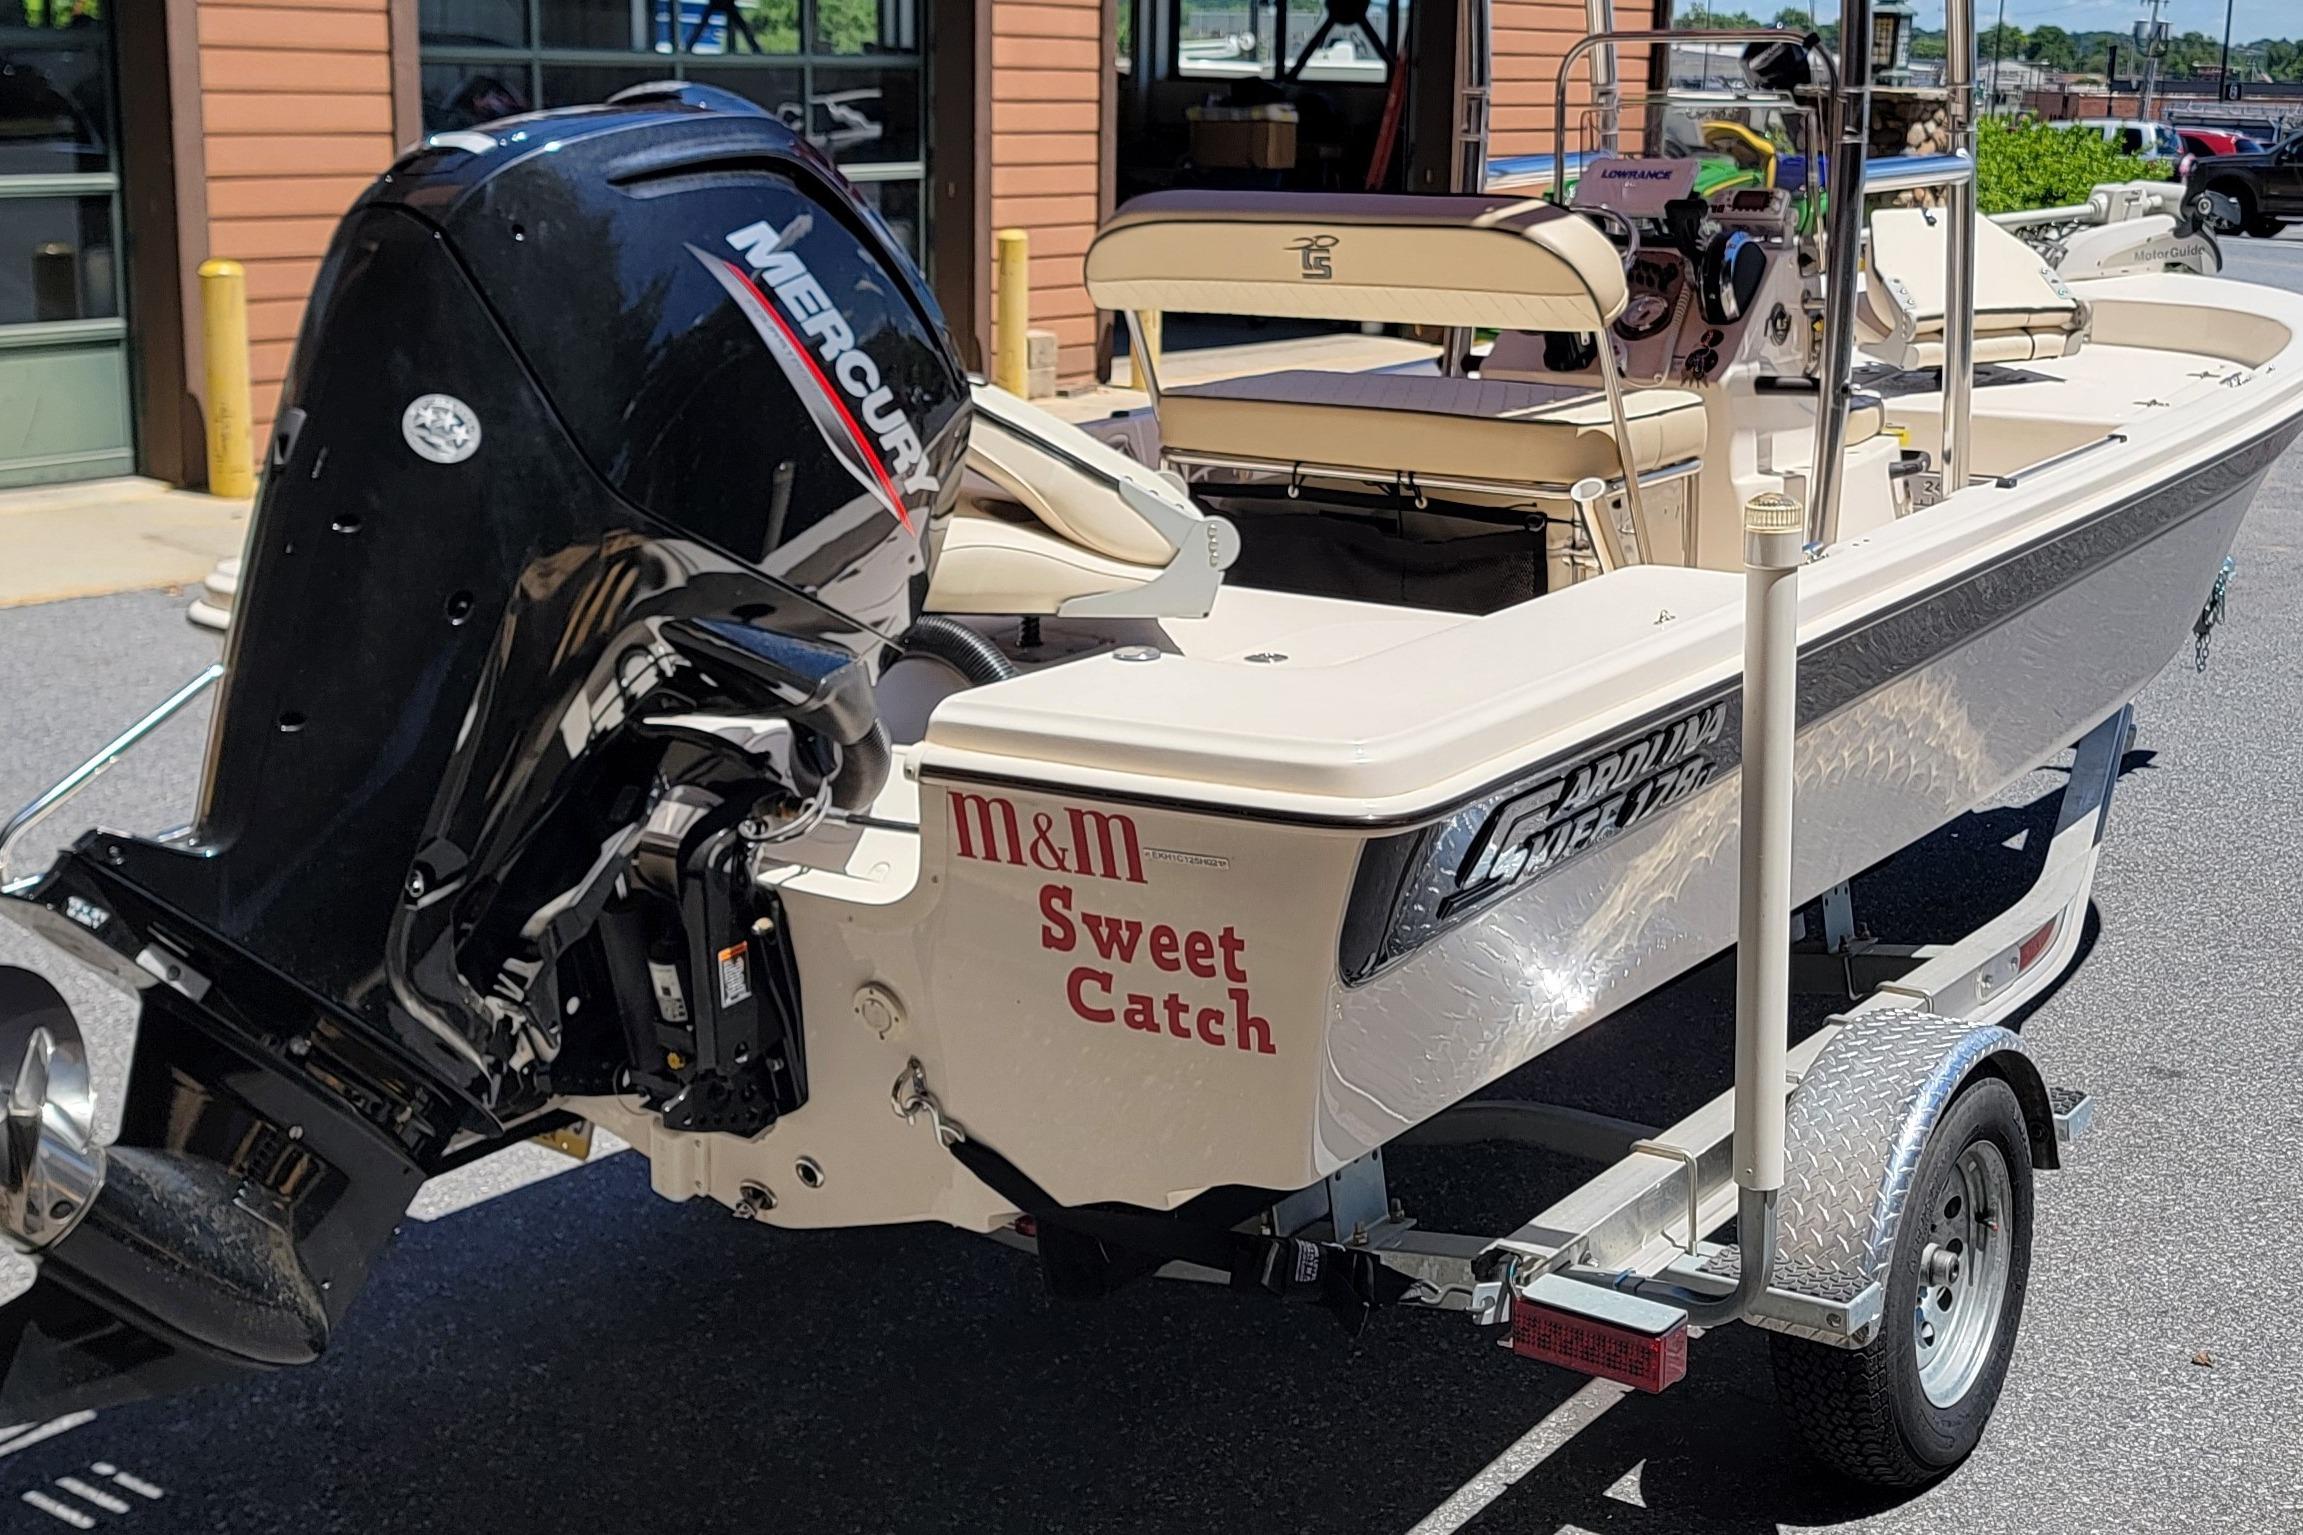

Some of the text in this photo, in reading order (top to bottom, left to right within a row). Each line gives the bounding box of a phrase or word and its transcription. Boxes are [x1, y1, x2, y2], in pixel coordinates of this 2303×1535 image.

[1600, 167, 1673, 181] LOWRANCE
[2133, 244, 2206, 262] MotorGuide
[725, 219, 940, 495] MERCURY
[1039, 884, 1248, 984] Sweet
[1066, 966, 1277, 1055] Catch
